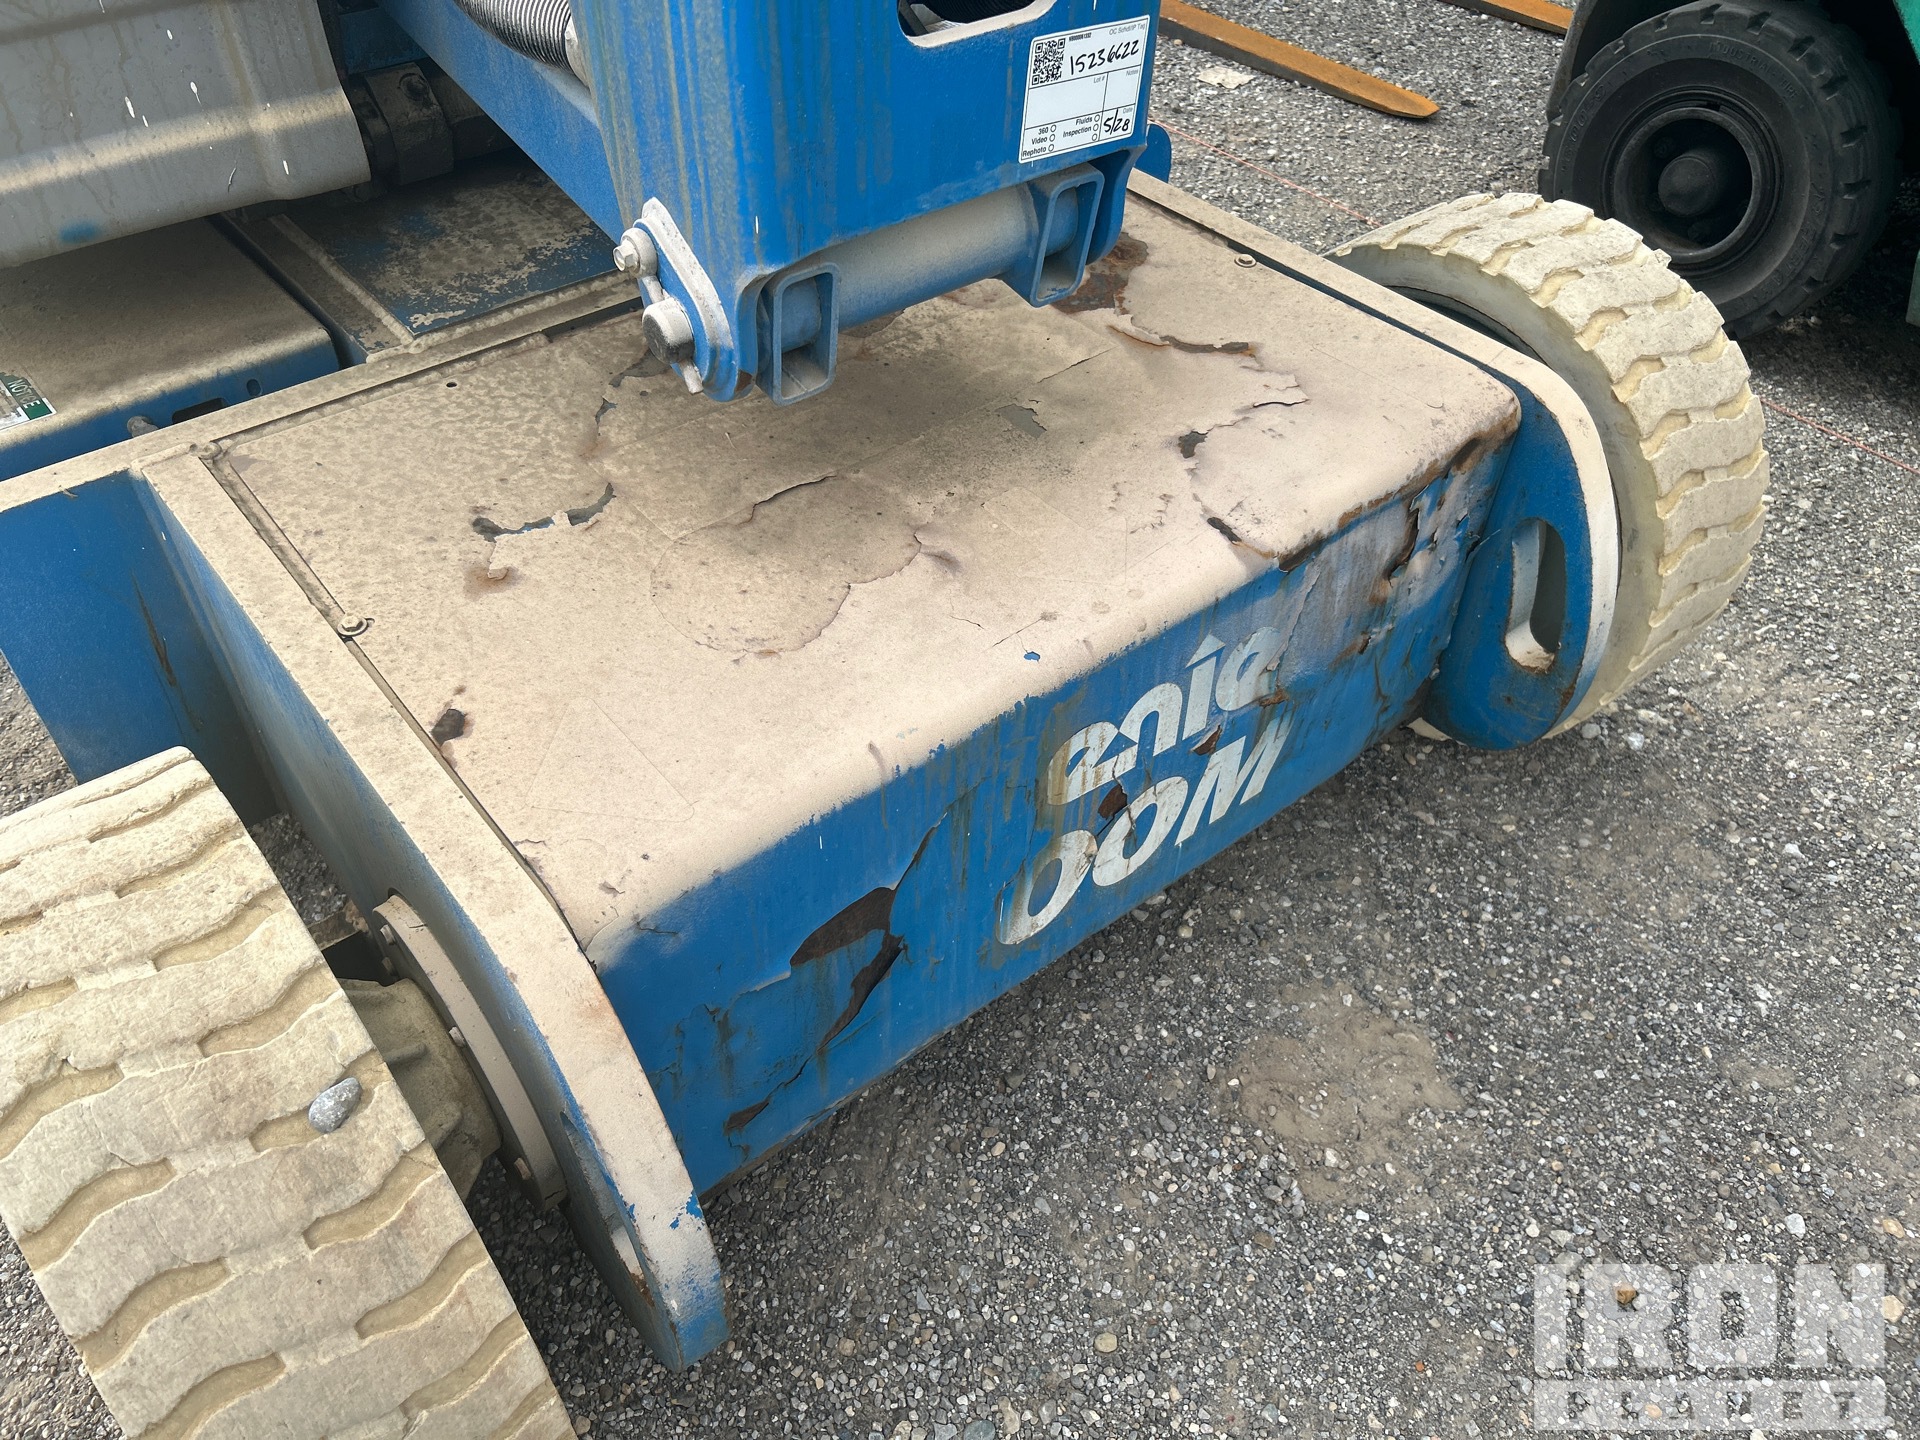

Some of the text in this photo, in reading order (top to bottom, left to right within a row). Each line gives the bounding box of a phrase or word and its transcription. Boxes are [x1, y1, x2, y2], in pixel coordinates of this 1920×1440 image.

[1137, 22, 1146, 30] Tag
[1069, 39, 1140, 76] 15236622
[1125, 69, 1139, 77] Notes
[1122, 107, 1133, 115] Date
[1075, 116, 1093, 126] Fluids
[1103, 108, 1130, 135] 5/28
[1038, 127, 1049, 135] 360
[1062, 126, 1092, 138] Inspection
[1031, 136, 1048, 145] Video
[1022, 146, 1047, 158] Rephoto
[7, 378, 41, 409] NOTICE
